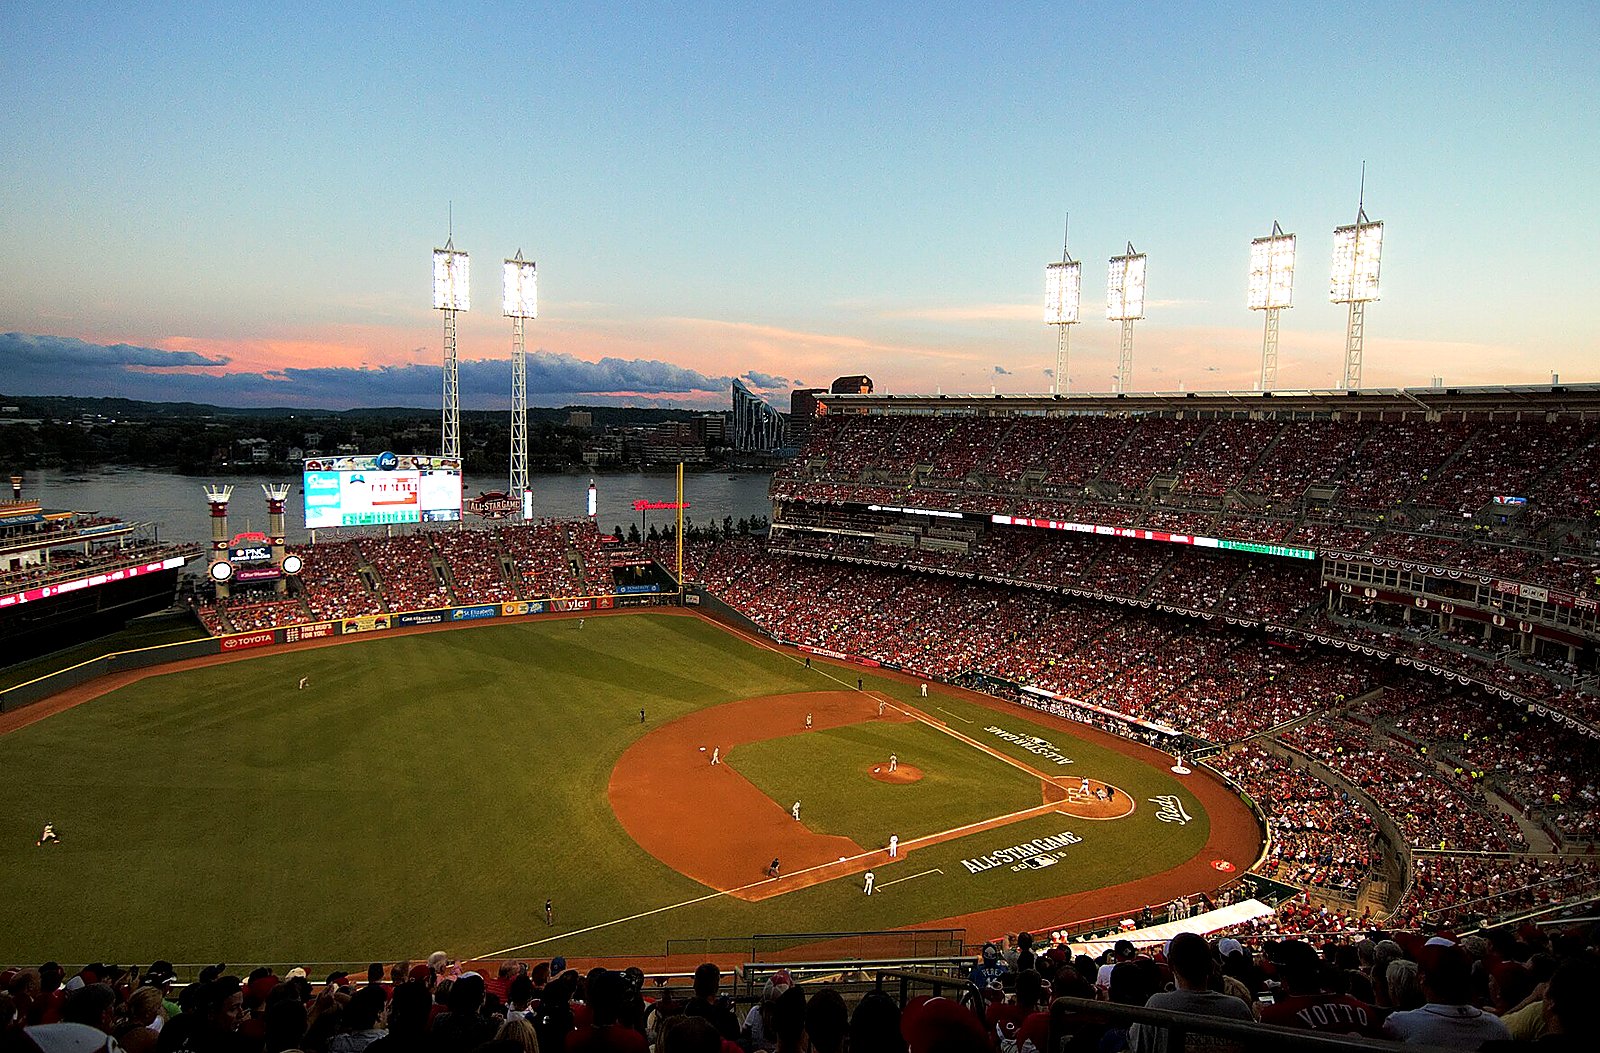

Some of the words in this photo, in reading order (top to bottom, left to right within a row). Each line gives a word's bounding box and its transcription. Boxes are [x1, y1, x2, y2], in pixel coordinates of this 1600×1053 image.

[381, 458, 396, 466] P&G
[501, 500, 520, 510] GAME
[245, 548, 265, 557] PNC
[1574, 597, 1597, 609] ESPN
[470, 608, 495, 616] Elizabeth
[301, 625, 314, 633] THIS
[315, 623, 332, 631] BUD'S
[238, 634, 272, 646] TOYOTA
[301, 631, 313, 639] FOR
[1147, 795, 1193, 826] Reds
[1031, 831, 1083, 852] GAME
[1296, 1003, 1368, 1029] VOTTO
